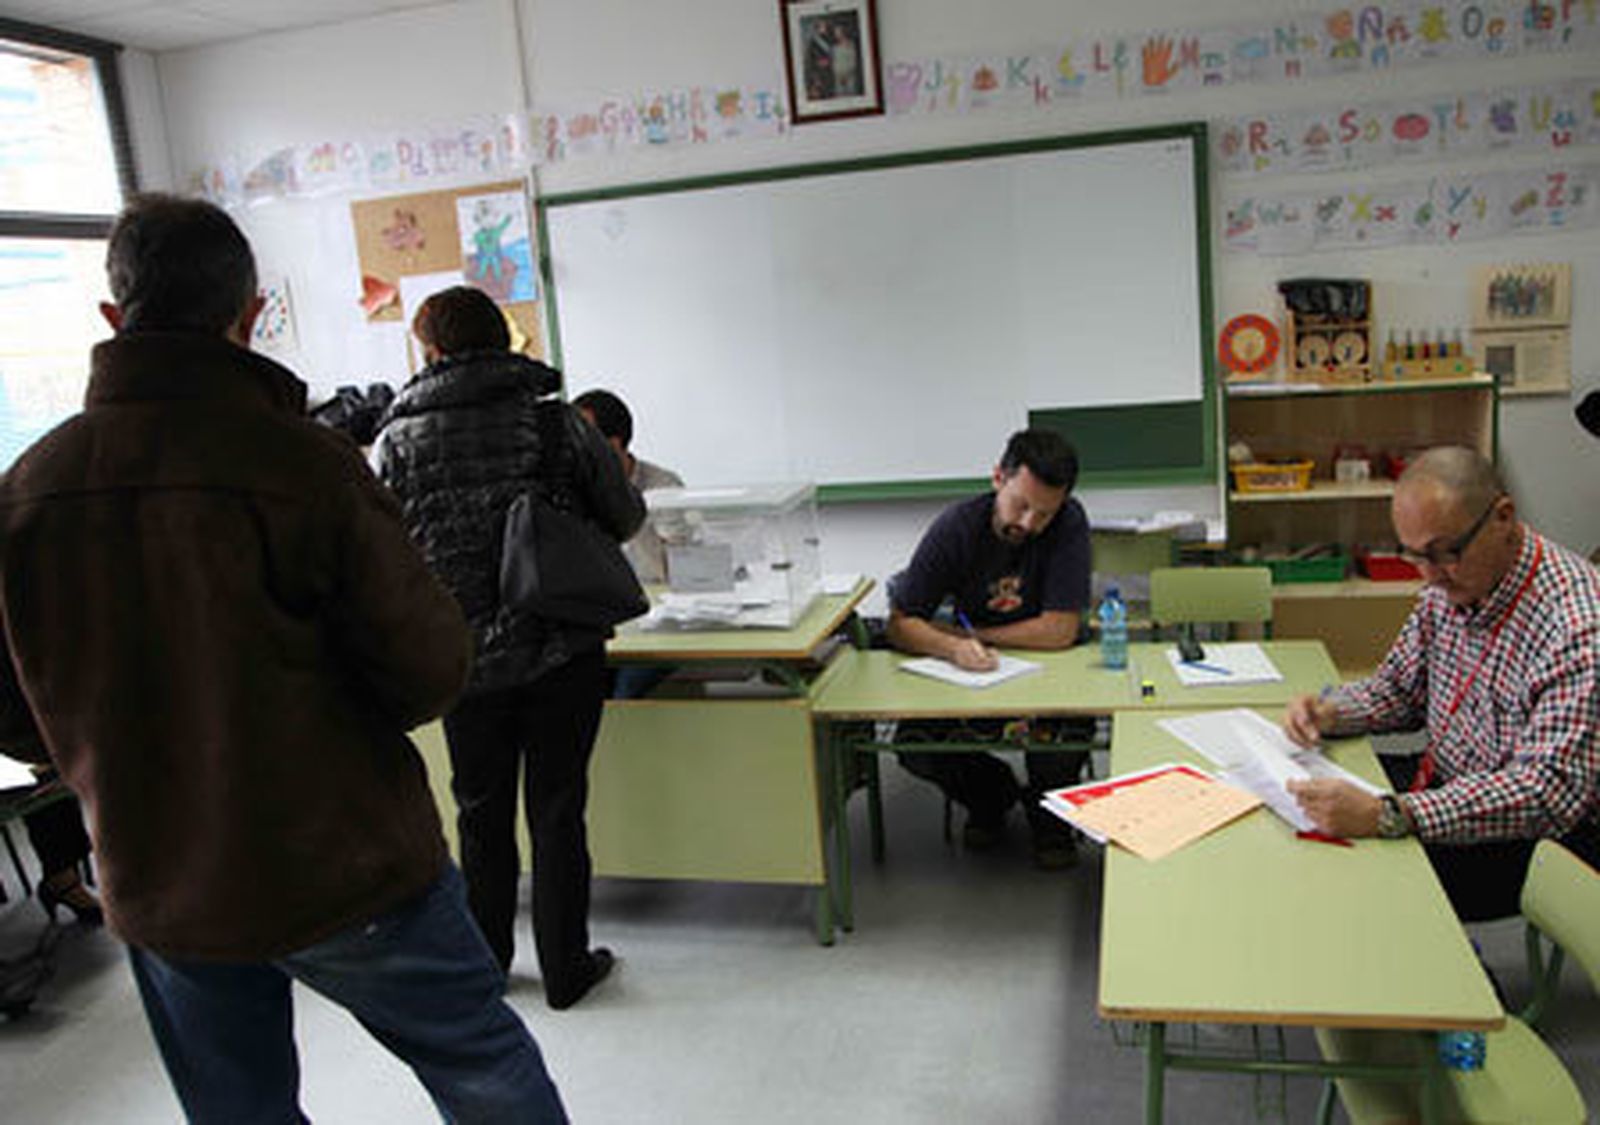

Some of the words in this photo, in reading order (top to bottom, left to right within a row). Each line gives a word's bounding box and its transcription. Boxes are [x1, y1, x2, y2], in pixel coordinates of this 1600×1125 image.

[924, 59, 942, 91] J
[1006, 56, 1030, 88] K
[1094, 41, 1110, 73] L
[1249, 120, 1268, 154] R
[1338, 108, 1359, 144] S
[1529, 96, 1551, 133] U
[1348, 193, 1373, 222] X
[1375, 205, 1397, 222] x
[1448, 186, 1472, 215] Y
[1546, 171, 1568, 208] Z
